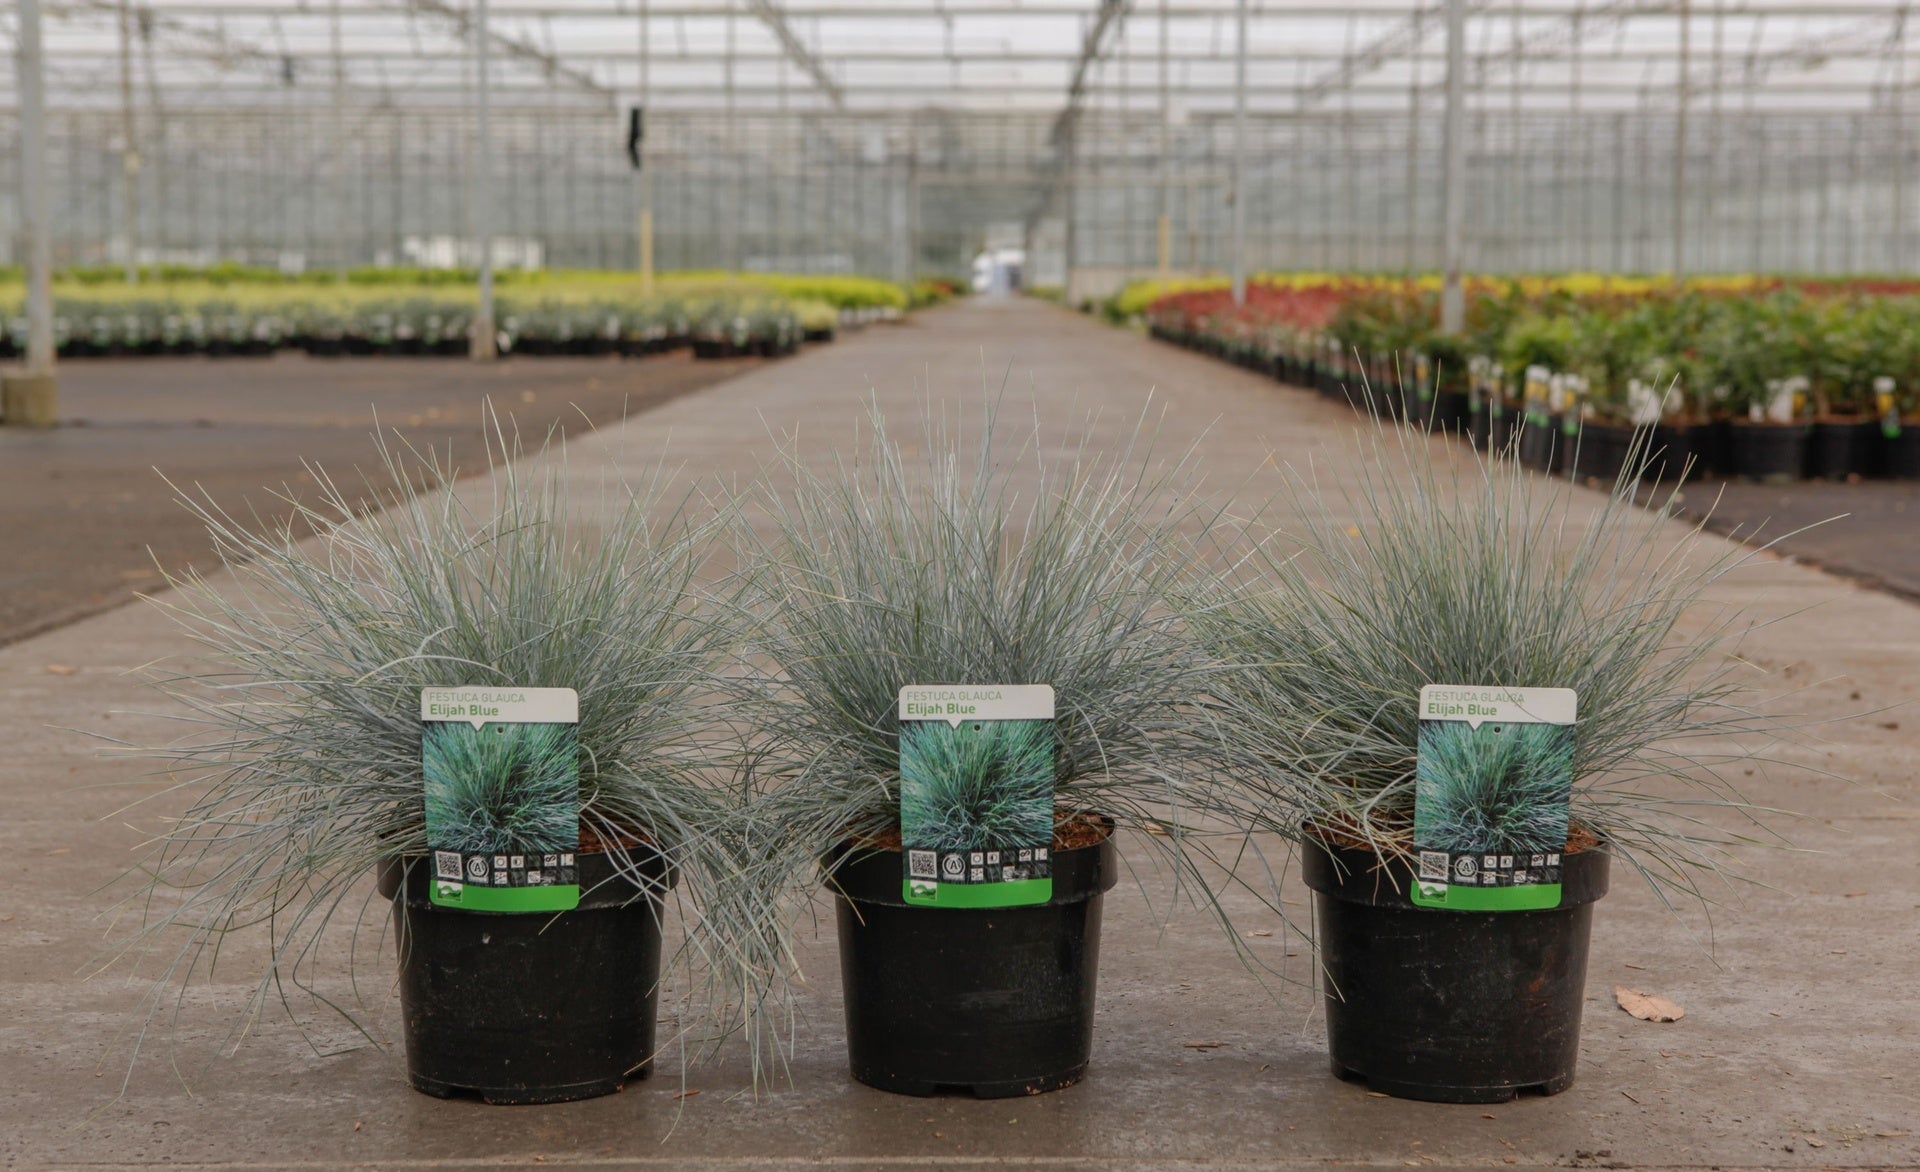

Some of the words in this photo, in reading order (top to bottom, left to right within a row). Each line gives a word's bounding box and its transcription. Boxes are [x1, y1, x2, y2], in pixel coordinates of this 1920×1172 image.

[429, 692, 479, 702] FESTUCA
[481, 693, 526, 703] GLAUCA
[907, 691, 956, 701] FESTUCA
[958, 691, 1003, 701] GLAUCA
[1428, 691, 1477, 702] FESTUCA
[1480, 692, 1525, 703] GLAUCA
[430, 704, 466, 717] Elijah
[469, 705, 499, 716] Blue
[907, 703, 943, 716] Elijah
[947, 703, 976, 714] Blue
[1428, 703, 1464, 717] Elijah
[1468, 704, 1498, 716] Blue
